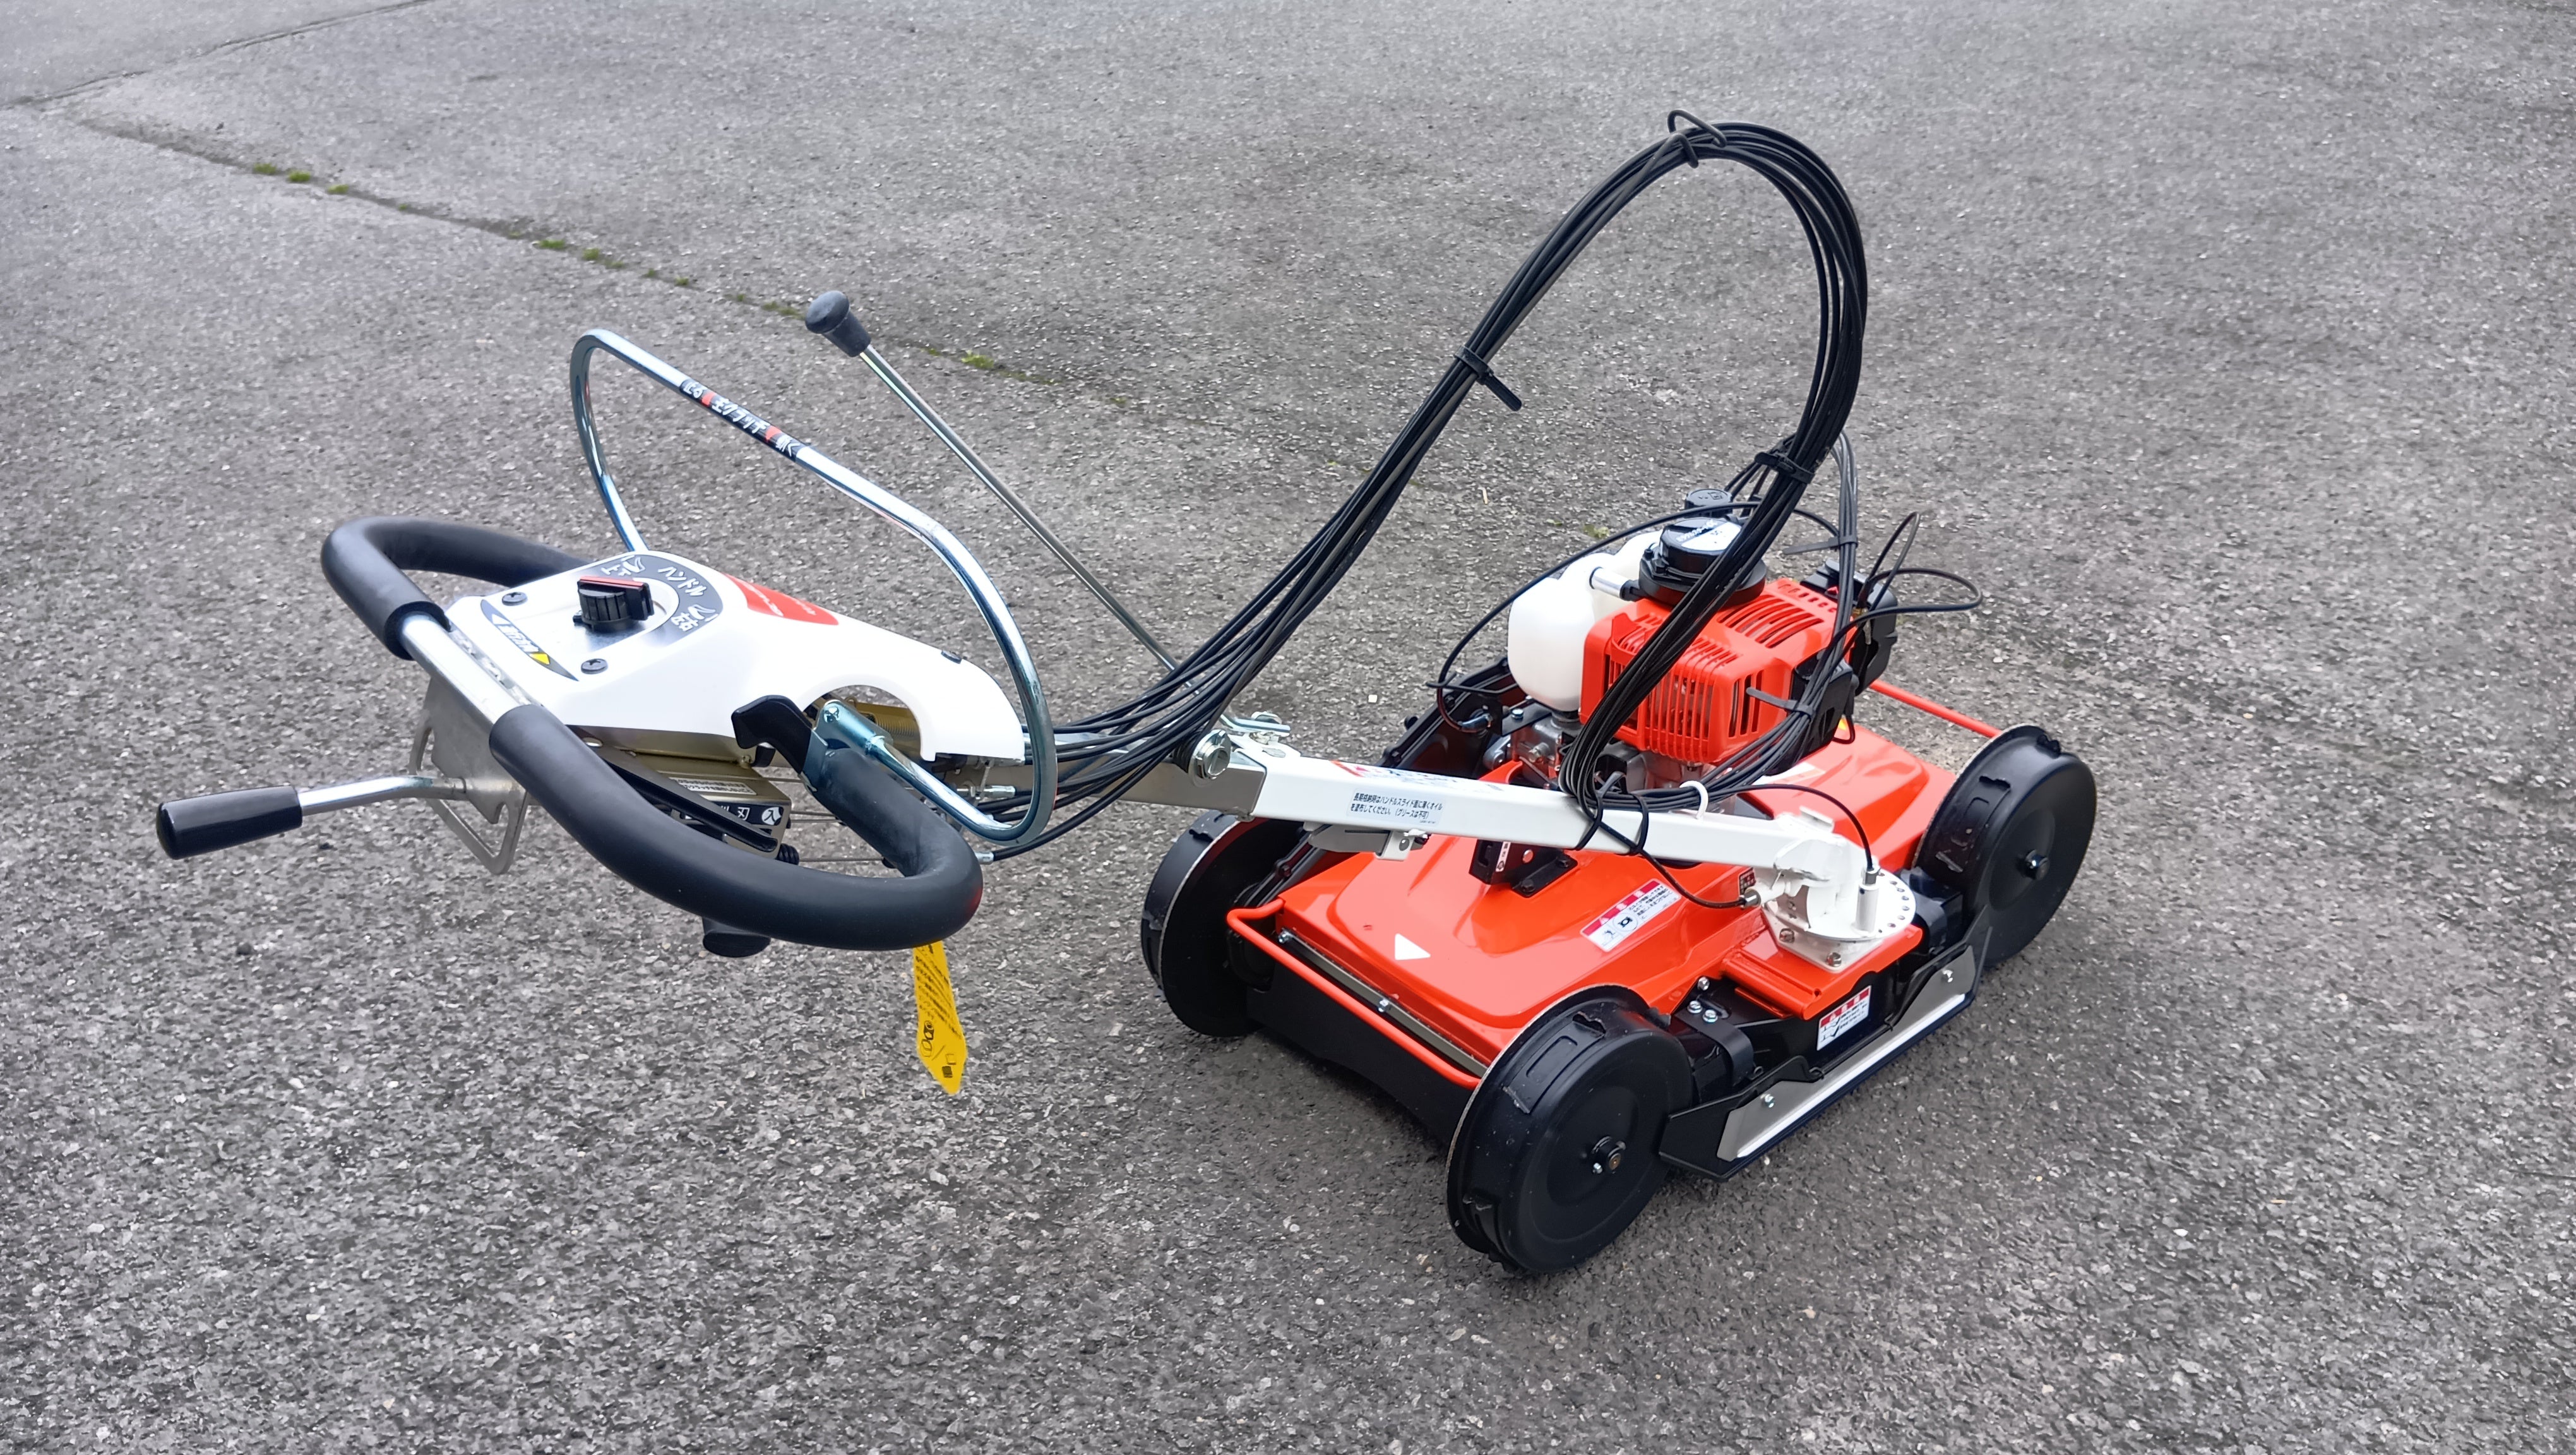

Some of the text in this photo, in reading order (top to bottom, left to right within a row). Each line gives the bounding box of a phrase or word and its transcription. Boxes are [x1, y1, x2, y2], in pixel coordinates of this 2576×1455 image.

[712, 398, 770, 434] 主クラッチ
[657, 566, 707, 596] ハンドル
